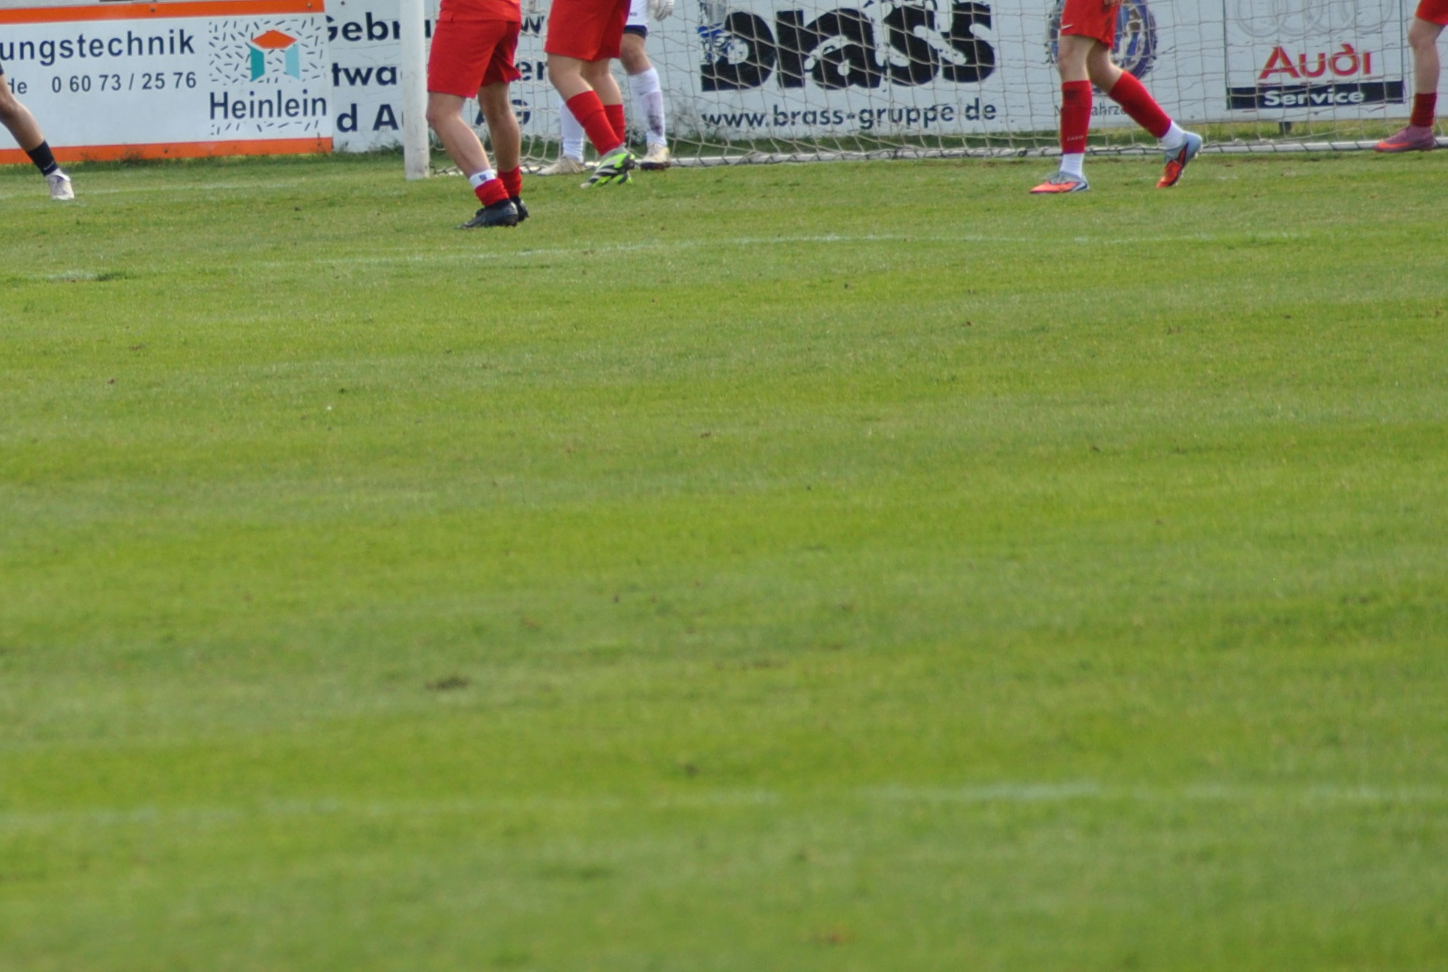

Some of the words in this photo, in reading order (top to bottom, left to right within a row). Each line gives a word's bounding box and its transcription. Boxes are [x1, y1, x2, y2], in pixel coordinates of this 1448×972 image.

[1258, 42, 1372, 80] Audi
[51, 76, 61, 92] 0
[69, 75, 91, 92] 60
[99, 74, 122, 91] 73
[141, 73, 165, 90] 25
[173, 72, 197, 89] 76
[1263, 88, 1366, 107] Service
[209, 89, 327, 120] Heinlein
[702, 97, 998, 129] www.brass-gruppede
